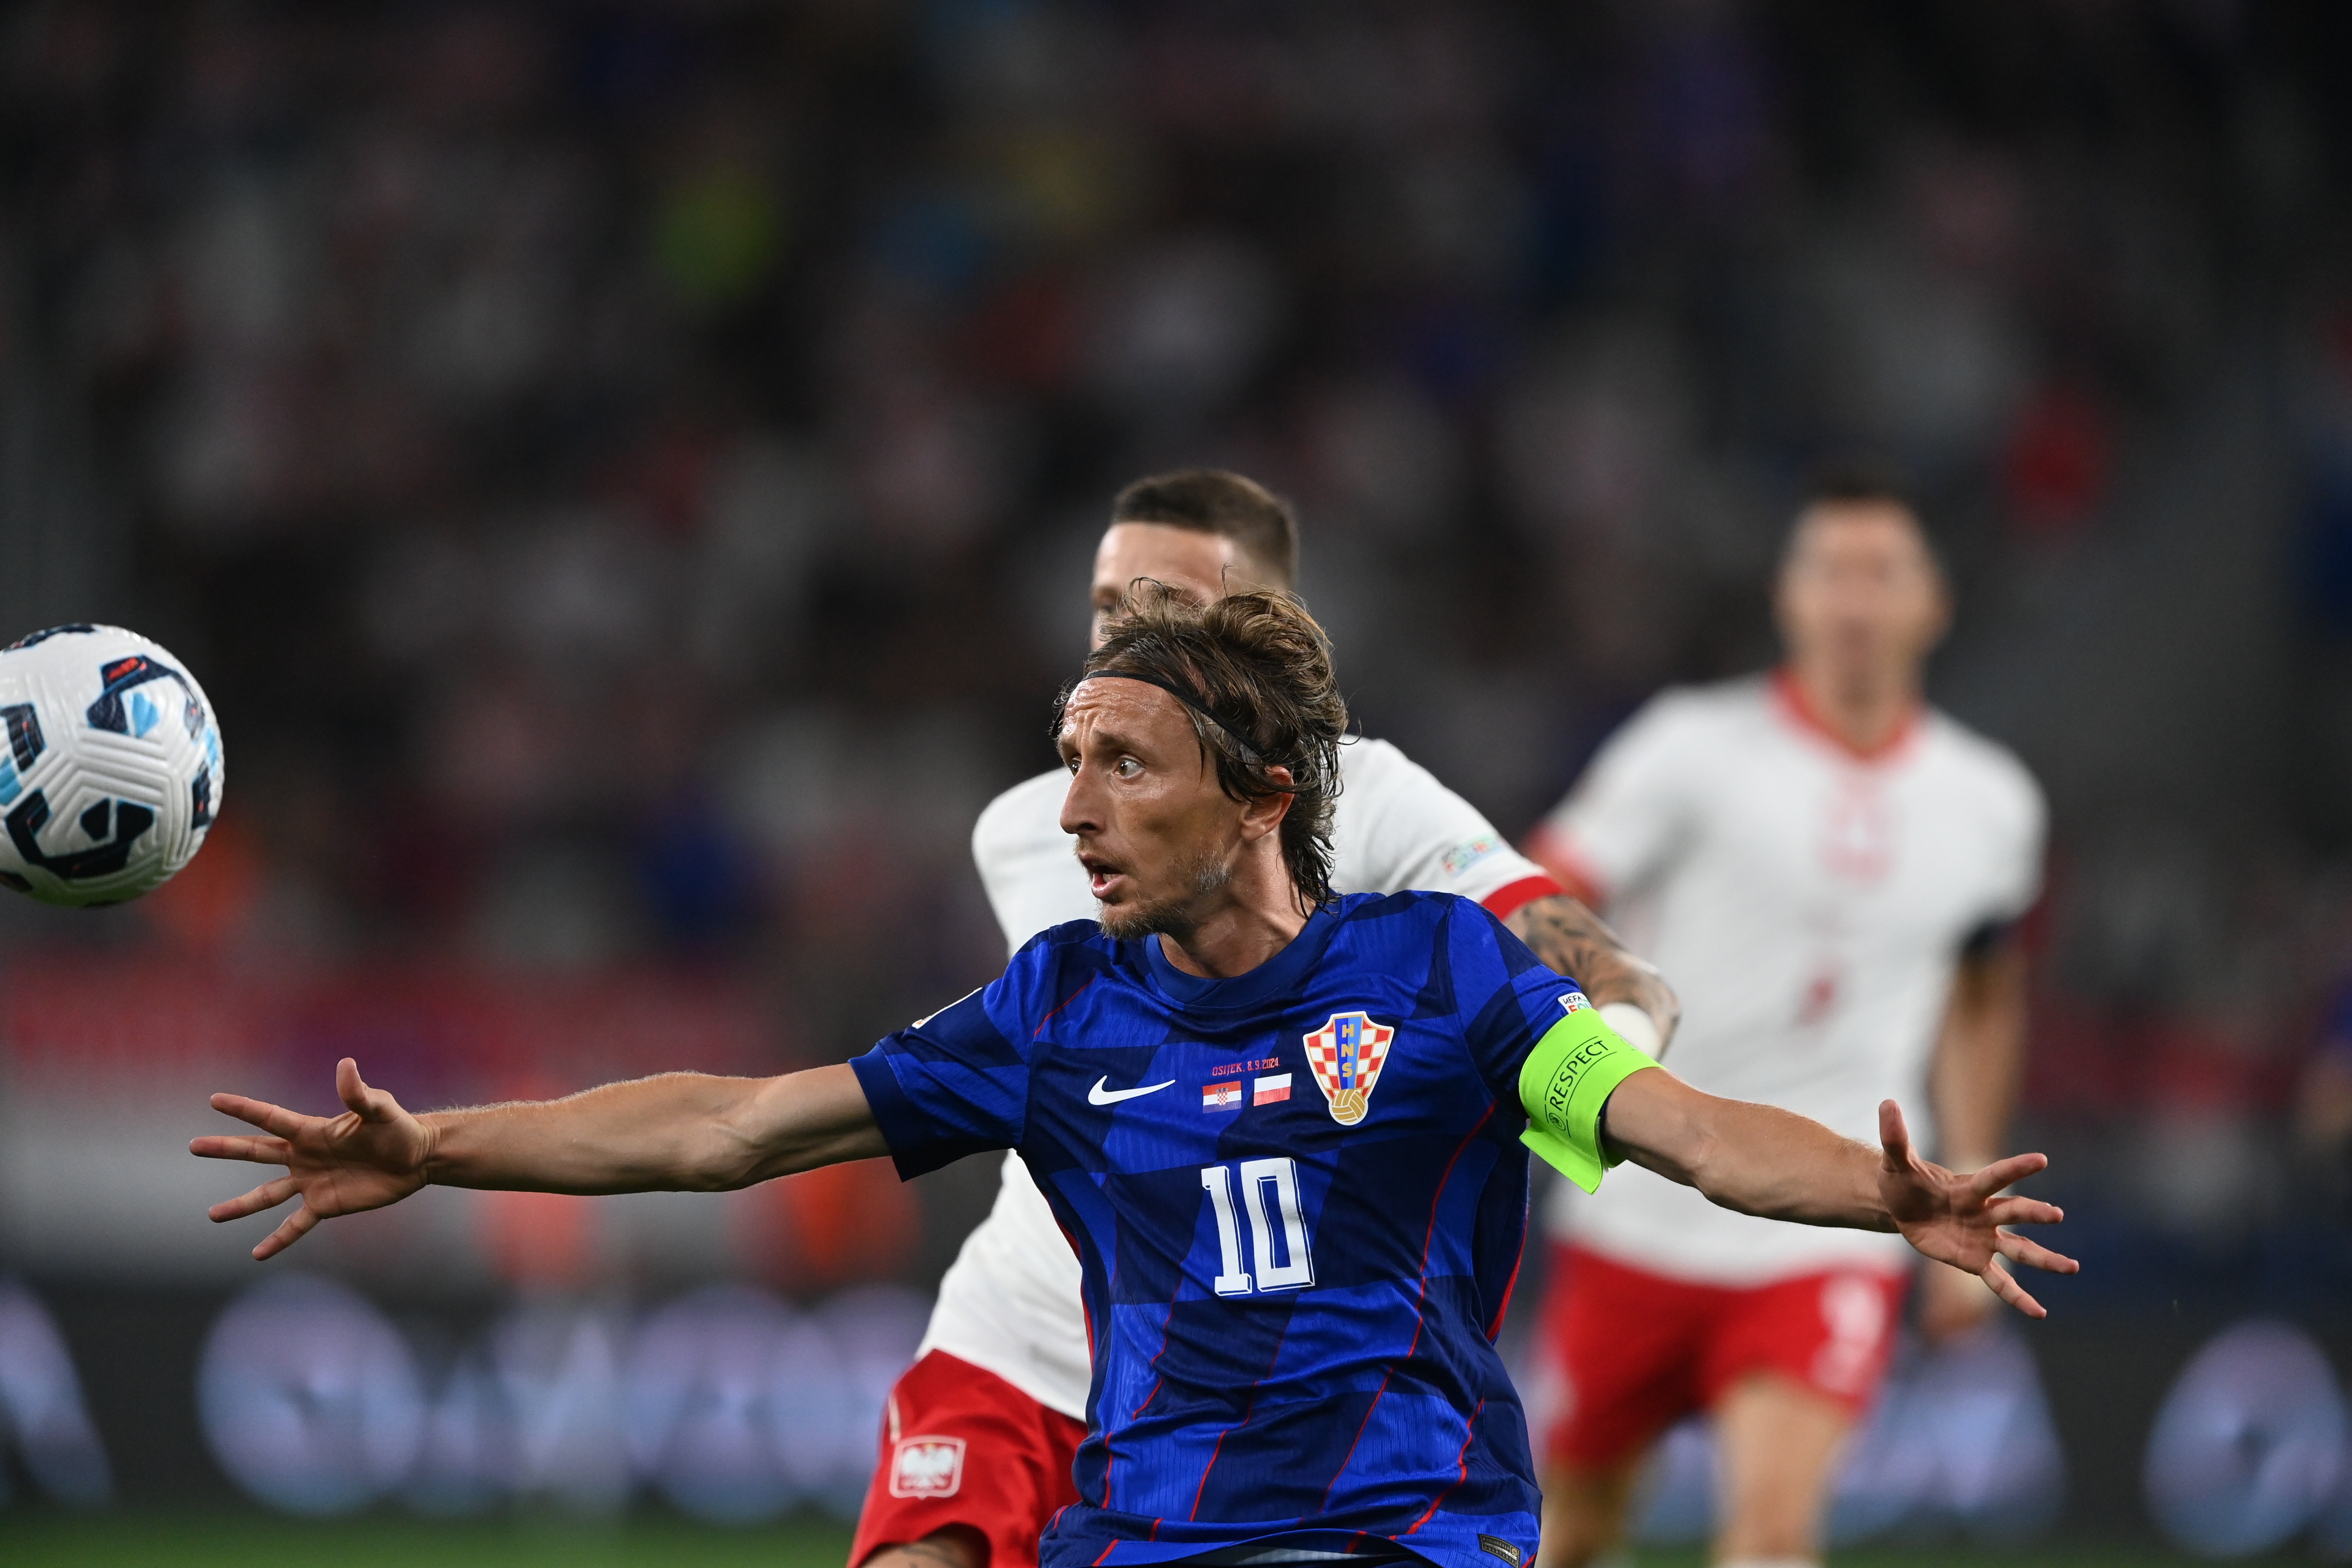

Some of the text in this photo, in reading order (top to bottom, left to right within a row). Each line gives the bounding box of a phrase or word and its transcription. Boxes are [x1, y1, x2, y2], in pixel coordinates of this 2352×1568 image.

[1563, 995, 1582, 1004] UEFA
[1212, 1063, 1245, 1076] OSIJEK,
[1341, 1024, 1355, 1078] HNS
[1549, 1040, 1609, 1111] RESPECT
[1201, 1157, 1315, 1296] 10
